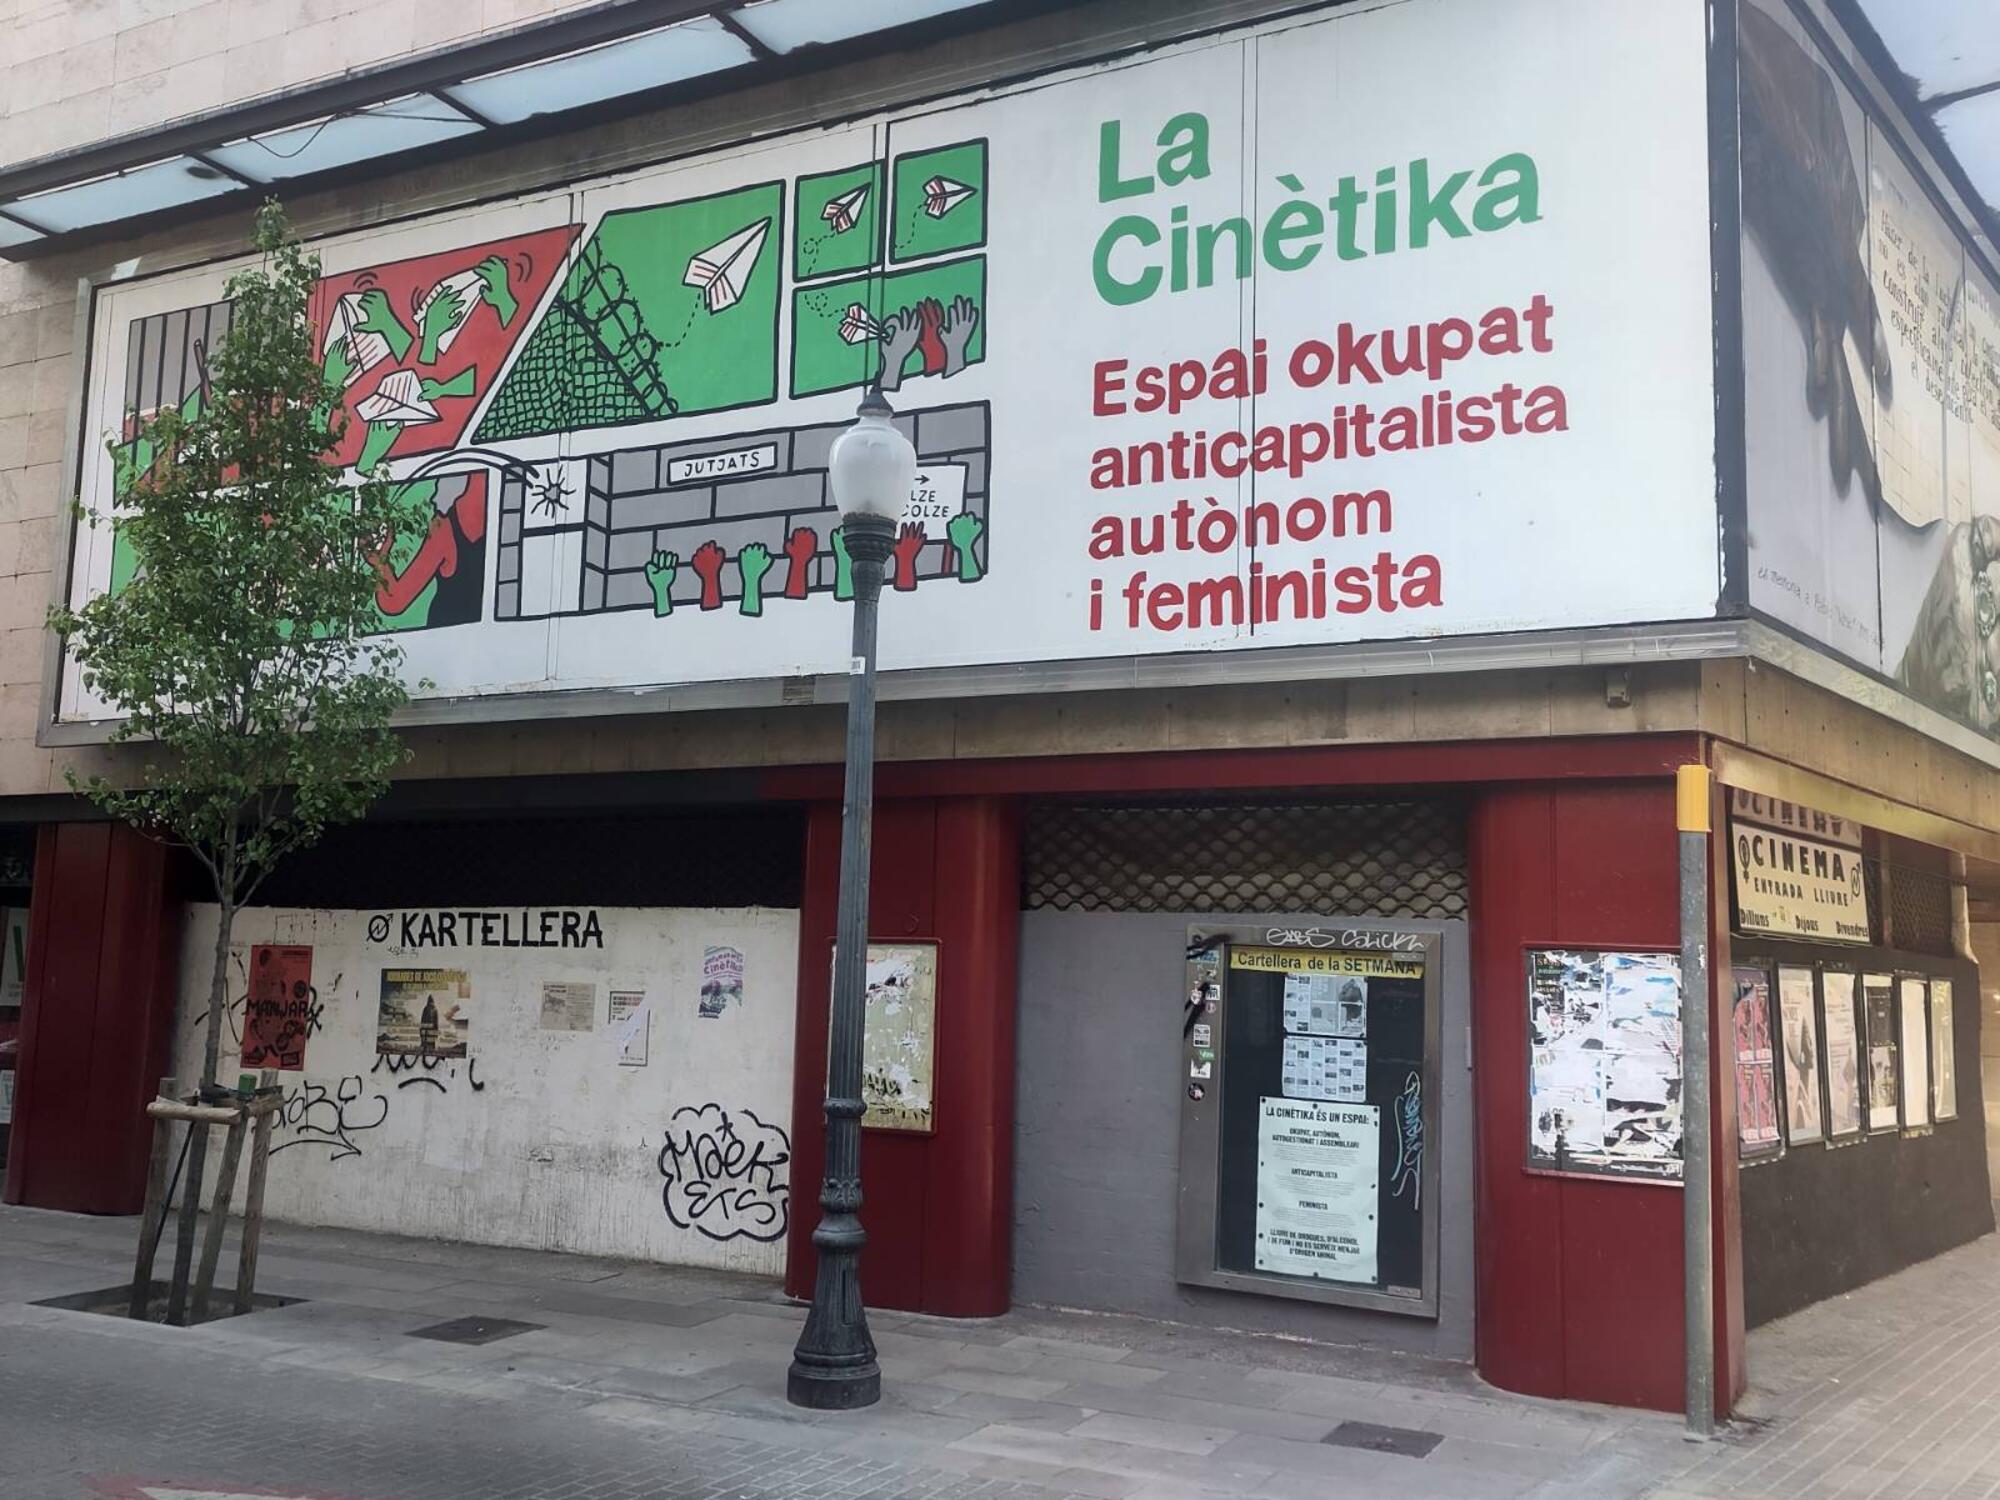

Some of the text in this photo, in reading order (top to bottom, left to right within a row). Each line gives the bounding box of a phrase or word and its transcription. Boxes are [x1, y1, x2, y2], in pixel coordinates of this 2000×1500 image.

[1098, 111, 1211, 204] La
[1092, 152, 1543, 306] Cinètika
[1093, 295, 1554, 417] Espai okupat
[1091, 383, 1569, 489] anticapitalista
[684, 452, 760, 477] JUTJATS
[1088, 489, 1393, 561] autònom
[1089, 552, 1443, 631] i feminista
[1752, 835, 1845, 882] CINEMA
[1754, 877, 1848, 907] ENTRADA LLIURE
[401, 910, 603, 948] KARTELLERA
[1740, 909, 1770, 928] Dilluns
[1795, 915, 1819, 932] Dijous
[1836, 921, 1869, 938] Divendres
[1238, 952, 1301, 969] Cartellera
[1308, 956, 1325, 970] de
[1328, 956, 1340, 971] la
[1344, 958, 1417, 975] SETMANA
[1266, 1107, 1275, 1117] LA
[1276, 1107, 1314, 1120] CINÈTIKA
[1316, 1110, 1327, 1122] ÉS
[1329, 1112, 1341, 1123] UN
